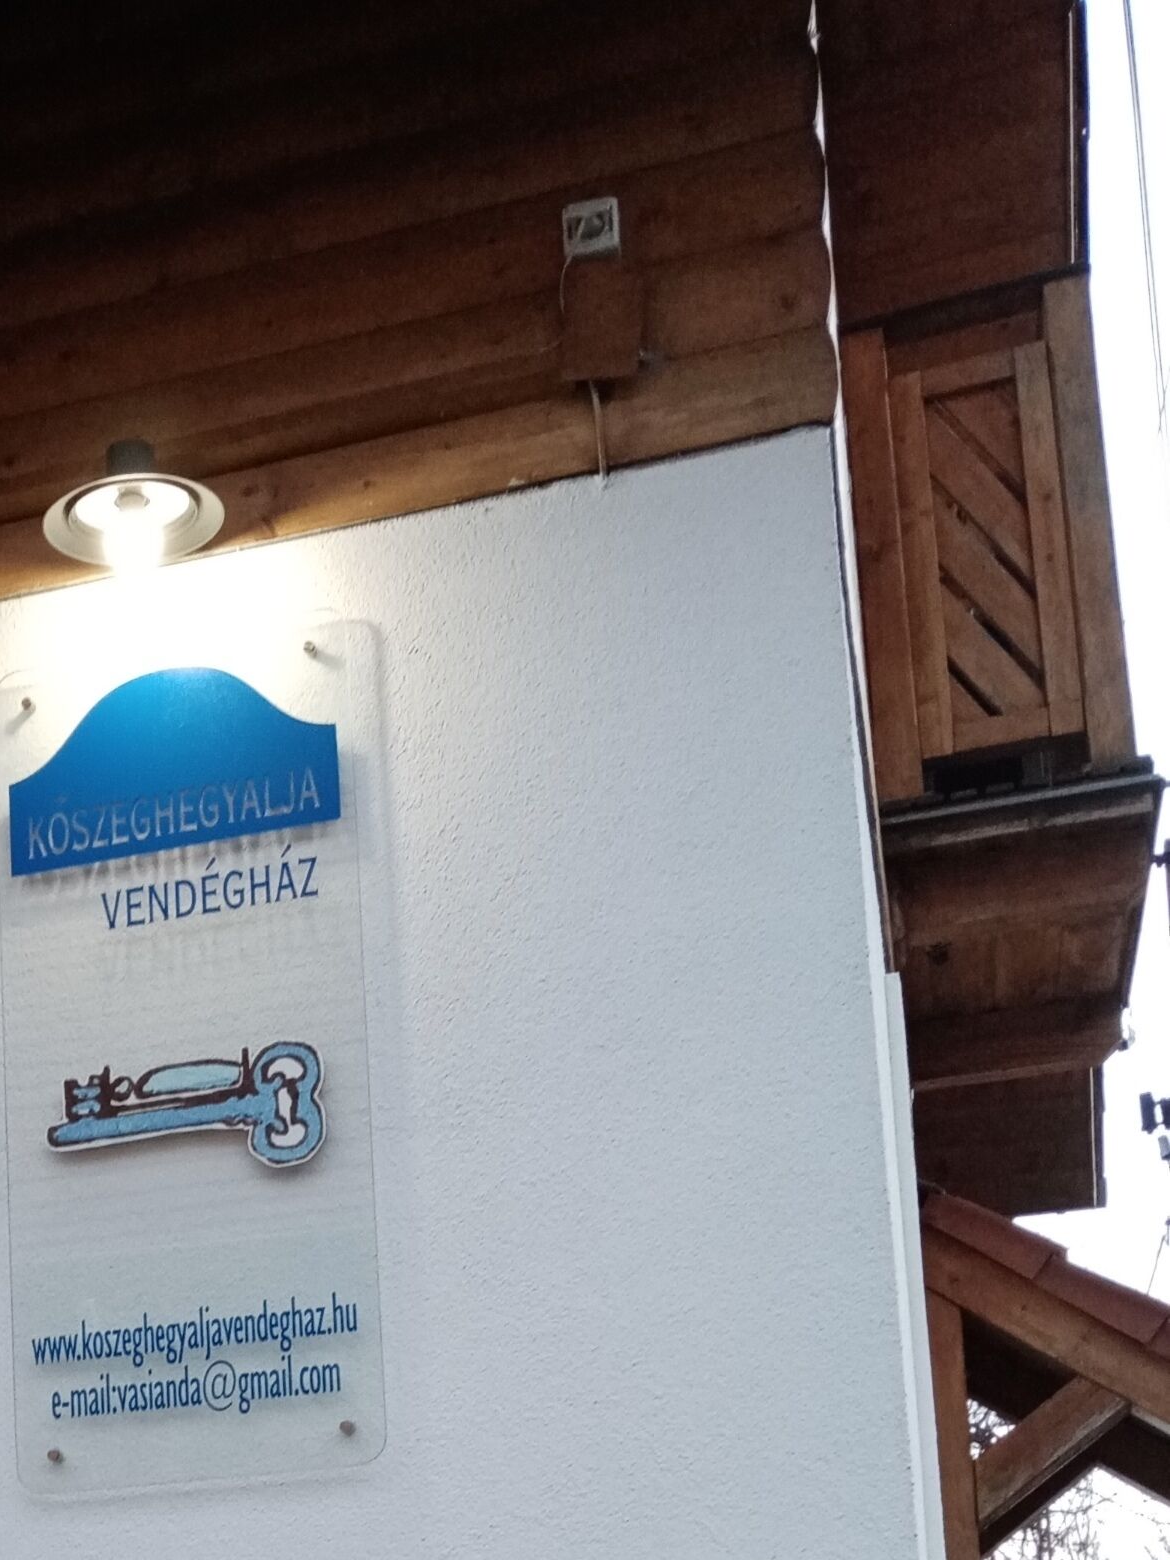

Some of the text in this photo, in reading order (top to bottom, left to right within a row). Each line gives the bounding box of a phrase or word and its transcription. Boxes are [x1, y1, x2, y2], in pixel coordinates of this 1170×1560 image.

[28, 767, 321, 861] KŐSZEGHEGYALJA
[101, 844, 319, 930] VENDÉGHÁZ
[32, 1292, 358, 1367] www.koszeghegyaljavendeghaz.hu
[51, 1355, 341, 1419] e-mail:vasianda@gmail.com
